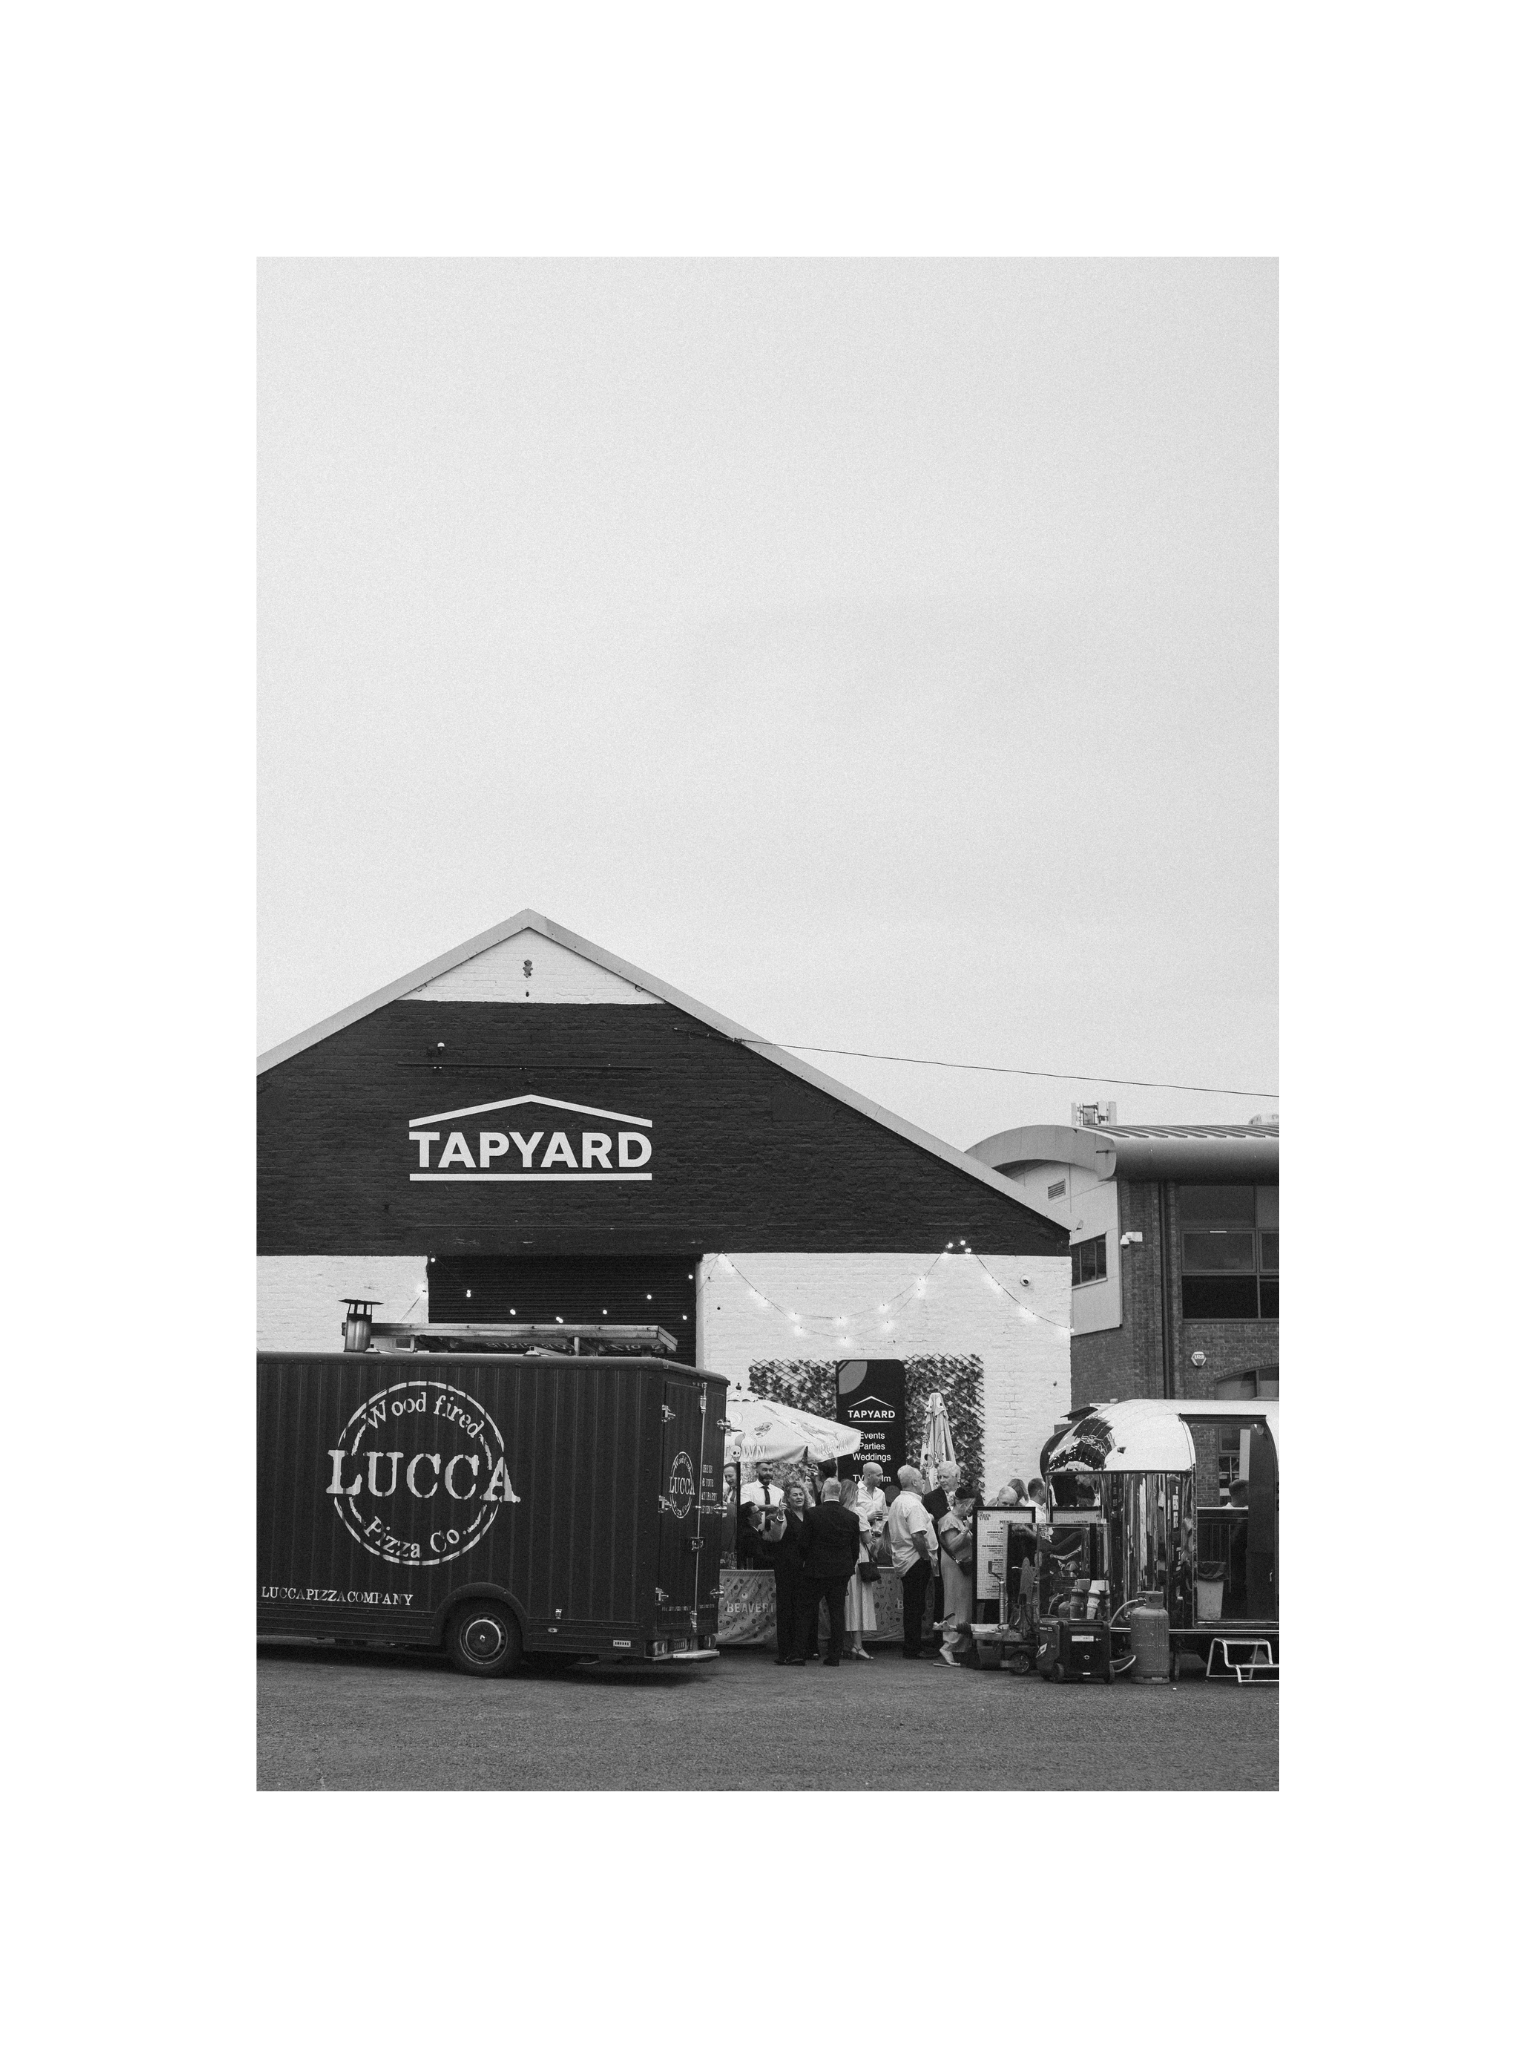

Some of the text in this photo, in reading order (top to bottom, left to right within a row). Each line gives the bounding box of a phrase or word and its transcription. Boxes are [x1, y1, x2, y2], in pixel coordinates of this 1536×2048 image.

[409, 1132, 652, 1168] TAPYARD
[361, 1392, 485, 1438] Wood fired
[847, 1410, 896, 1419] TAPYARD
[860, 1431, 885, 1439] Events
[859, 1442, 886, 1450] Parties
[853, 1453, 891, 1462] Weddings
[326, 1450, 521, 1503] LUCCA
[669, 1477, 696, 1495] LUCCA
[364, 1516, 421, 1558] Pizza
